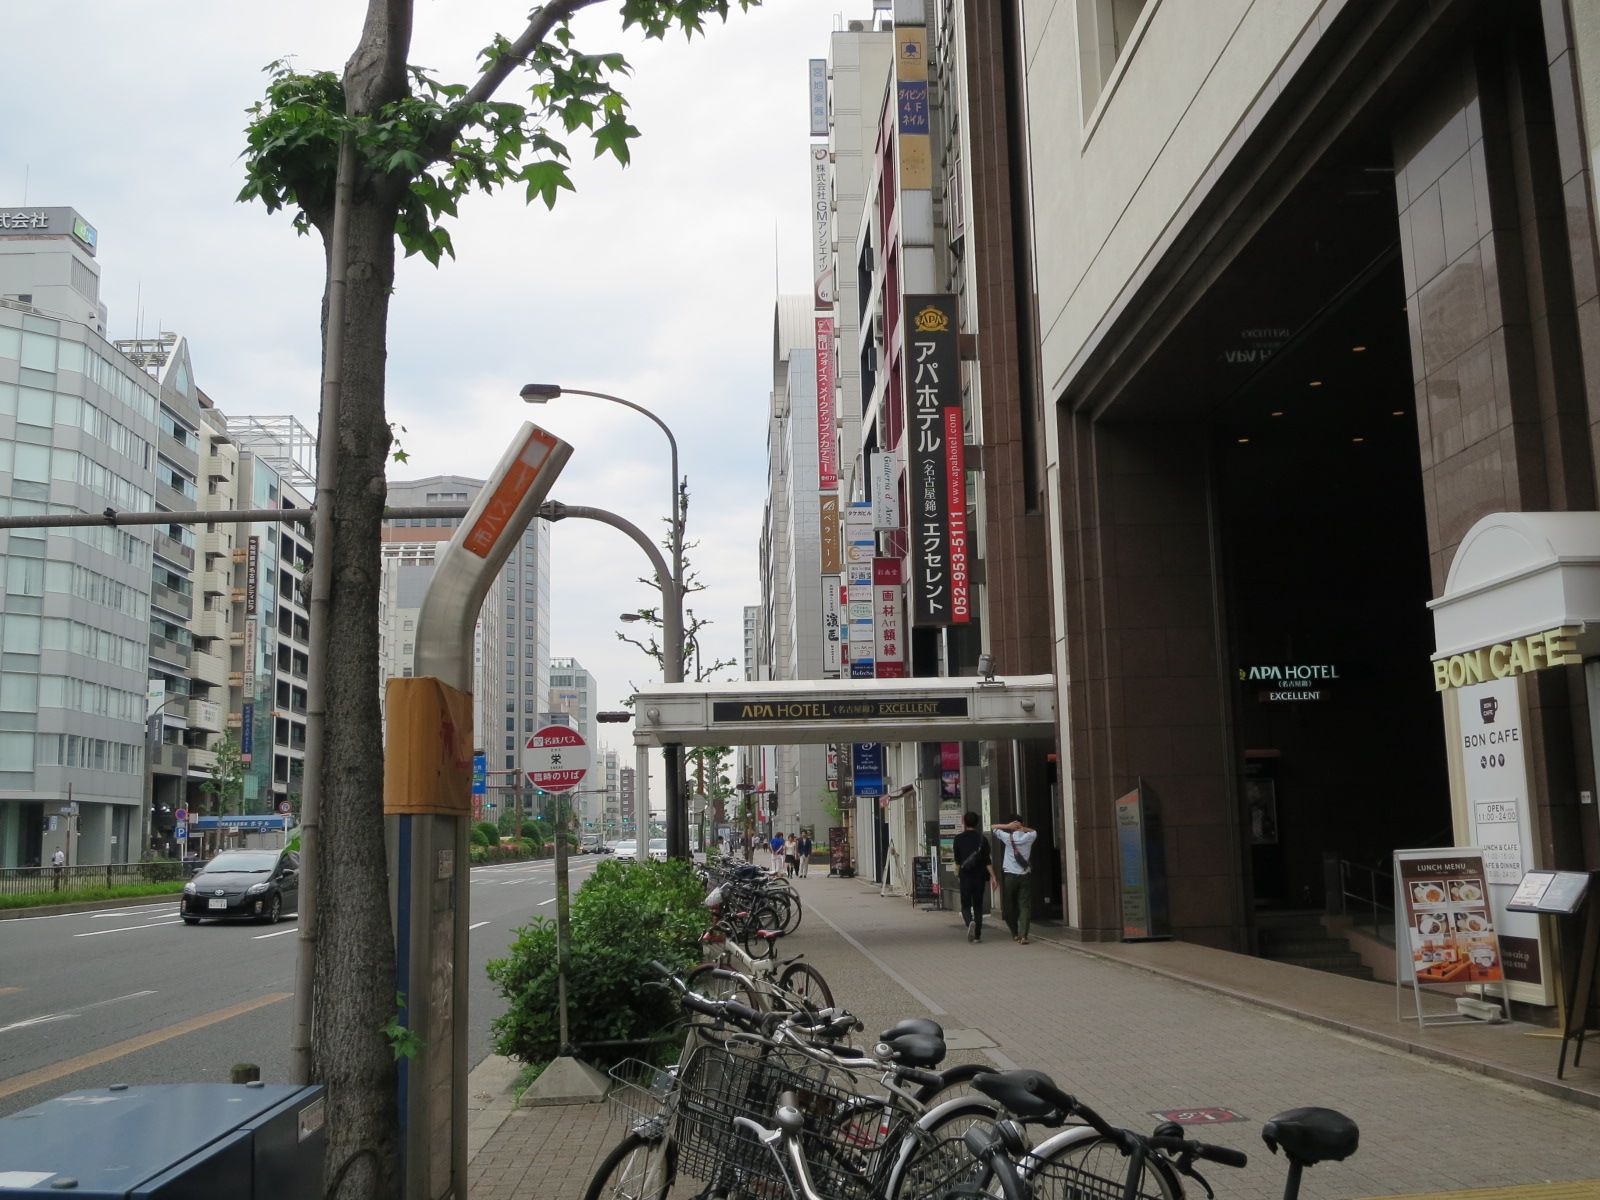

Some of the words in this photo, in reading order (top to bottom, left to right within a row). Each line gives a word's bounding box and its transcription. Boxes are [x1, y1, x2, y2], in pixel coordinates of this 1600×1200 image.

[899, 89, 926, 100] ダイビング
[902, 115, 925, 125] ネイル
[920, 315, 944, 324] APA
[948, 413, 961, 504] www.apahotel.com
[951, 511, 967, 615] 052-953-5111
[882, 590, 895, 617] 画材
[1433, 650, 1484, 691] BON
[1489, 627, 1580, 679] CAFE
[1249, 665, 1282, 680] APA
[1285, 664, 1340, 679] HOTEL
[1270, 691, 1320, 700] EXCELLENT
[742, 705, 774, 718] APA
[778, 703, 831, 717] HOTEL
[879, 703, 938, 713] EXCELLENT
[544, 736, 576, 746] 名鉄バス
[1464, 733, 1486, 748] BON
[1489, 728, 1519, 745] CAFE
[551, 753, 562, 765] 栄
[533, 771, 580, 782] 臨時のりば
[1487, 804, 1505, 813] OPEN
[1417, 864, 1443, 872] LUNCH
